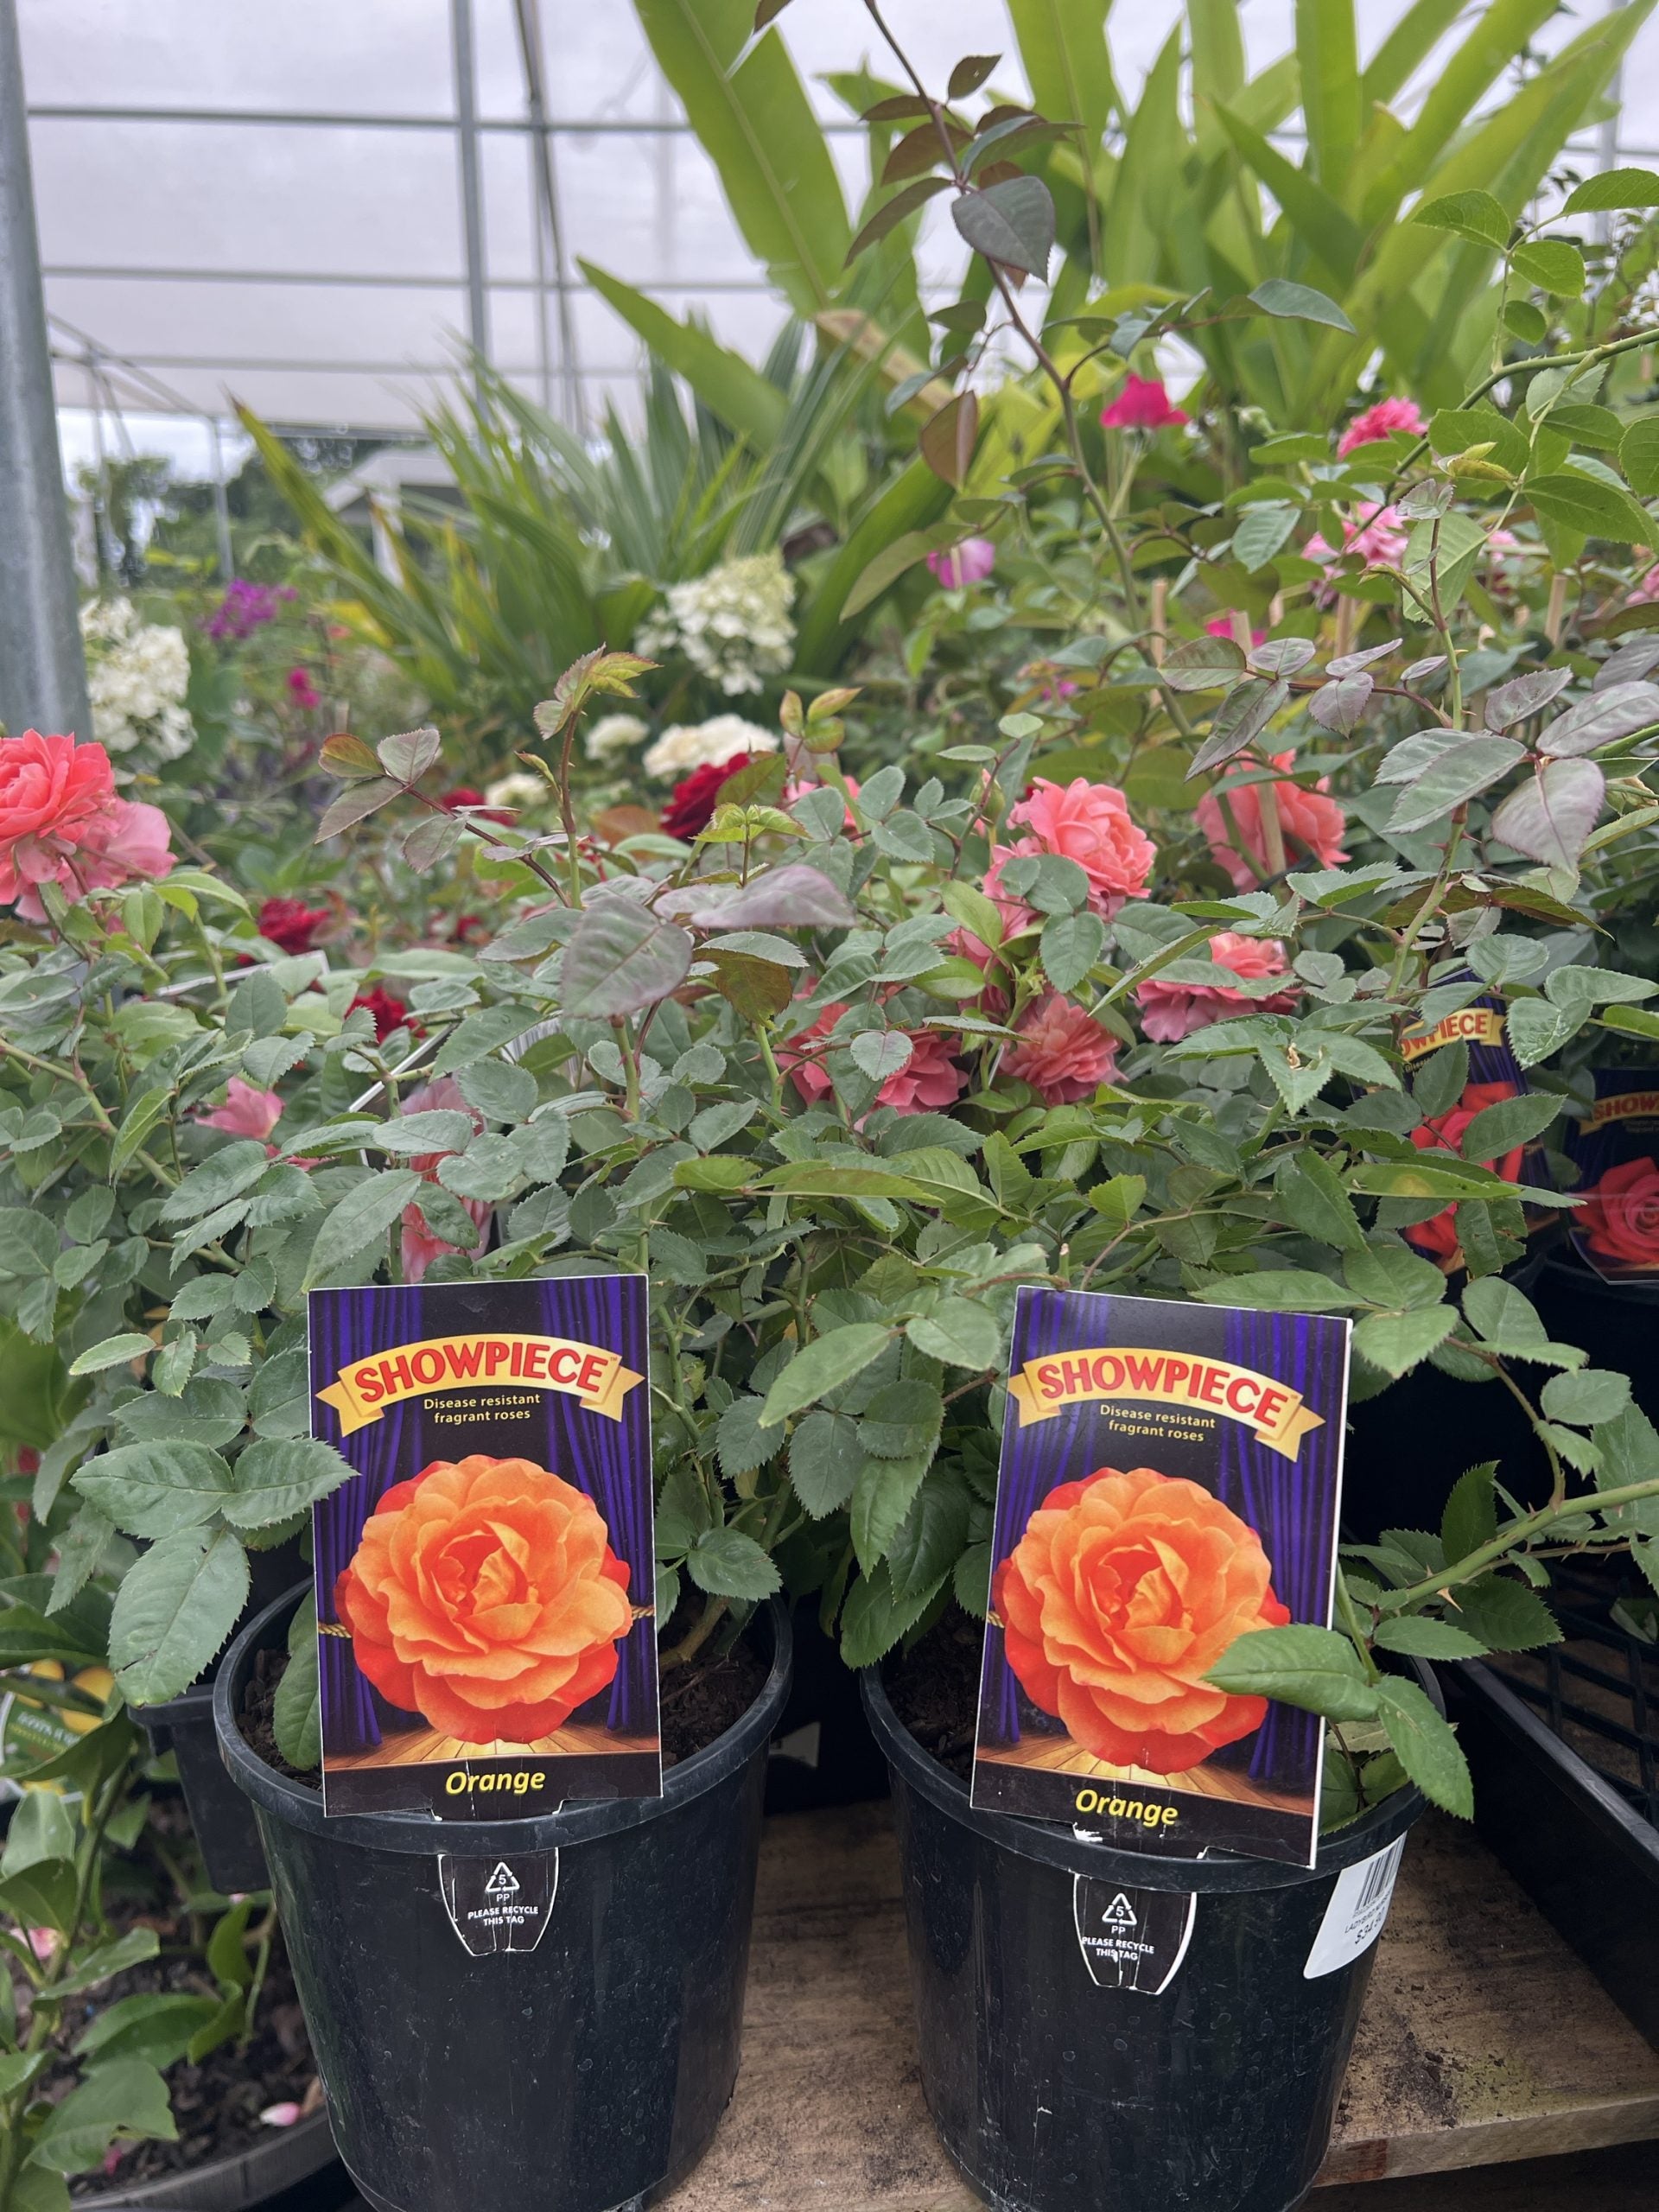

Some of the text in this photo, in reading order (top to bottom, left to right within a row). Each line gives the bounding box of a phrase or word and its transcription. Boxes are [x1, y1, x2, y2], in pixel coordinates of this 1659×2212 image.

[354, 1341, 608, 1403] SHOWPIECE
[1038, 1355, 1288, 1427] SHOWPIECE
[423, 1394, 541, 1409] Disease resistant
[434, 1410, 531, 1425] fragrant roses
[1100, 1404, 1216, 1428] Disease resistant
[1109, 1420, 1205, 1442] fragrant roses
[445, 1771, 546, 1796] Orange
[1075, 1788, 1179, 1827] Orange
[499, 1874, 506, 1885] 5
[496, 1893, 510, 1902] PP
[467, 1905, 538, 1920] PLEASE RECYCLE
[1116, 1906, 1125, 1917] 5
[483, 1916, 524, 1926] THIS TAG
[1111, 1925, 1126, 1935] PP
[1082, 1936, 1155, 1955] PLEASE RECYCLE
[1096, 1948, 1138, 1961] THIS TAG
